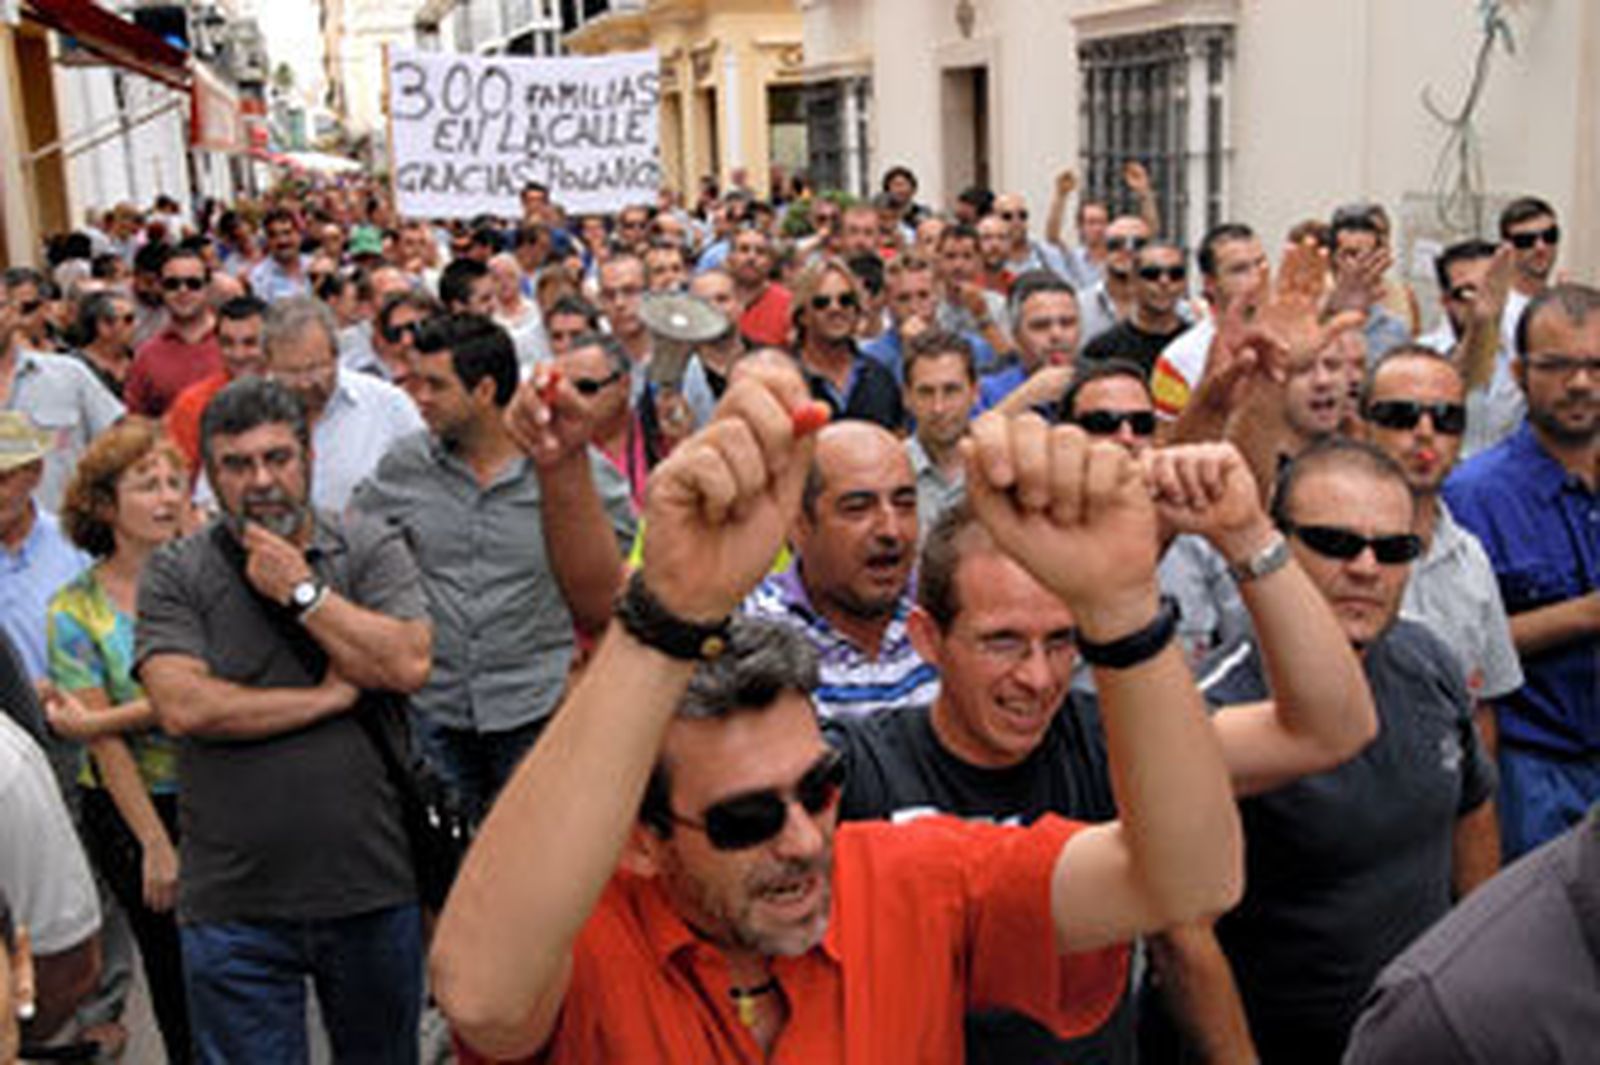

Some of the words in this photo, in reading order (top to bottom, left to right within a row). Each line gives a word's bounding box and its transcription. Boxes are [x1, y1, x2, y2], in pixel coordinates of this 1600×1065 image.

[393, 61, 513, 120] 300
[524, 72, 660, 111] FAMILIAS
[433, 116, 485, 155] EN
[499, 114, 545, 153] LA
[548, 107, 650, 149] CALLE
[396, 160, 533, 196] GRACIAS
